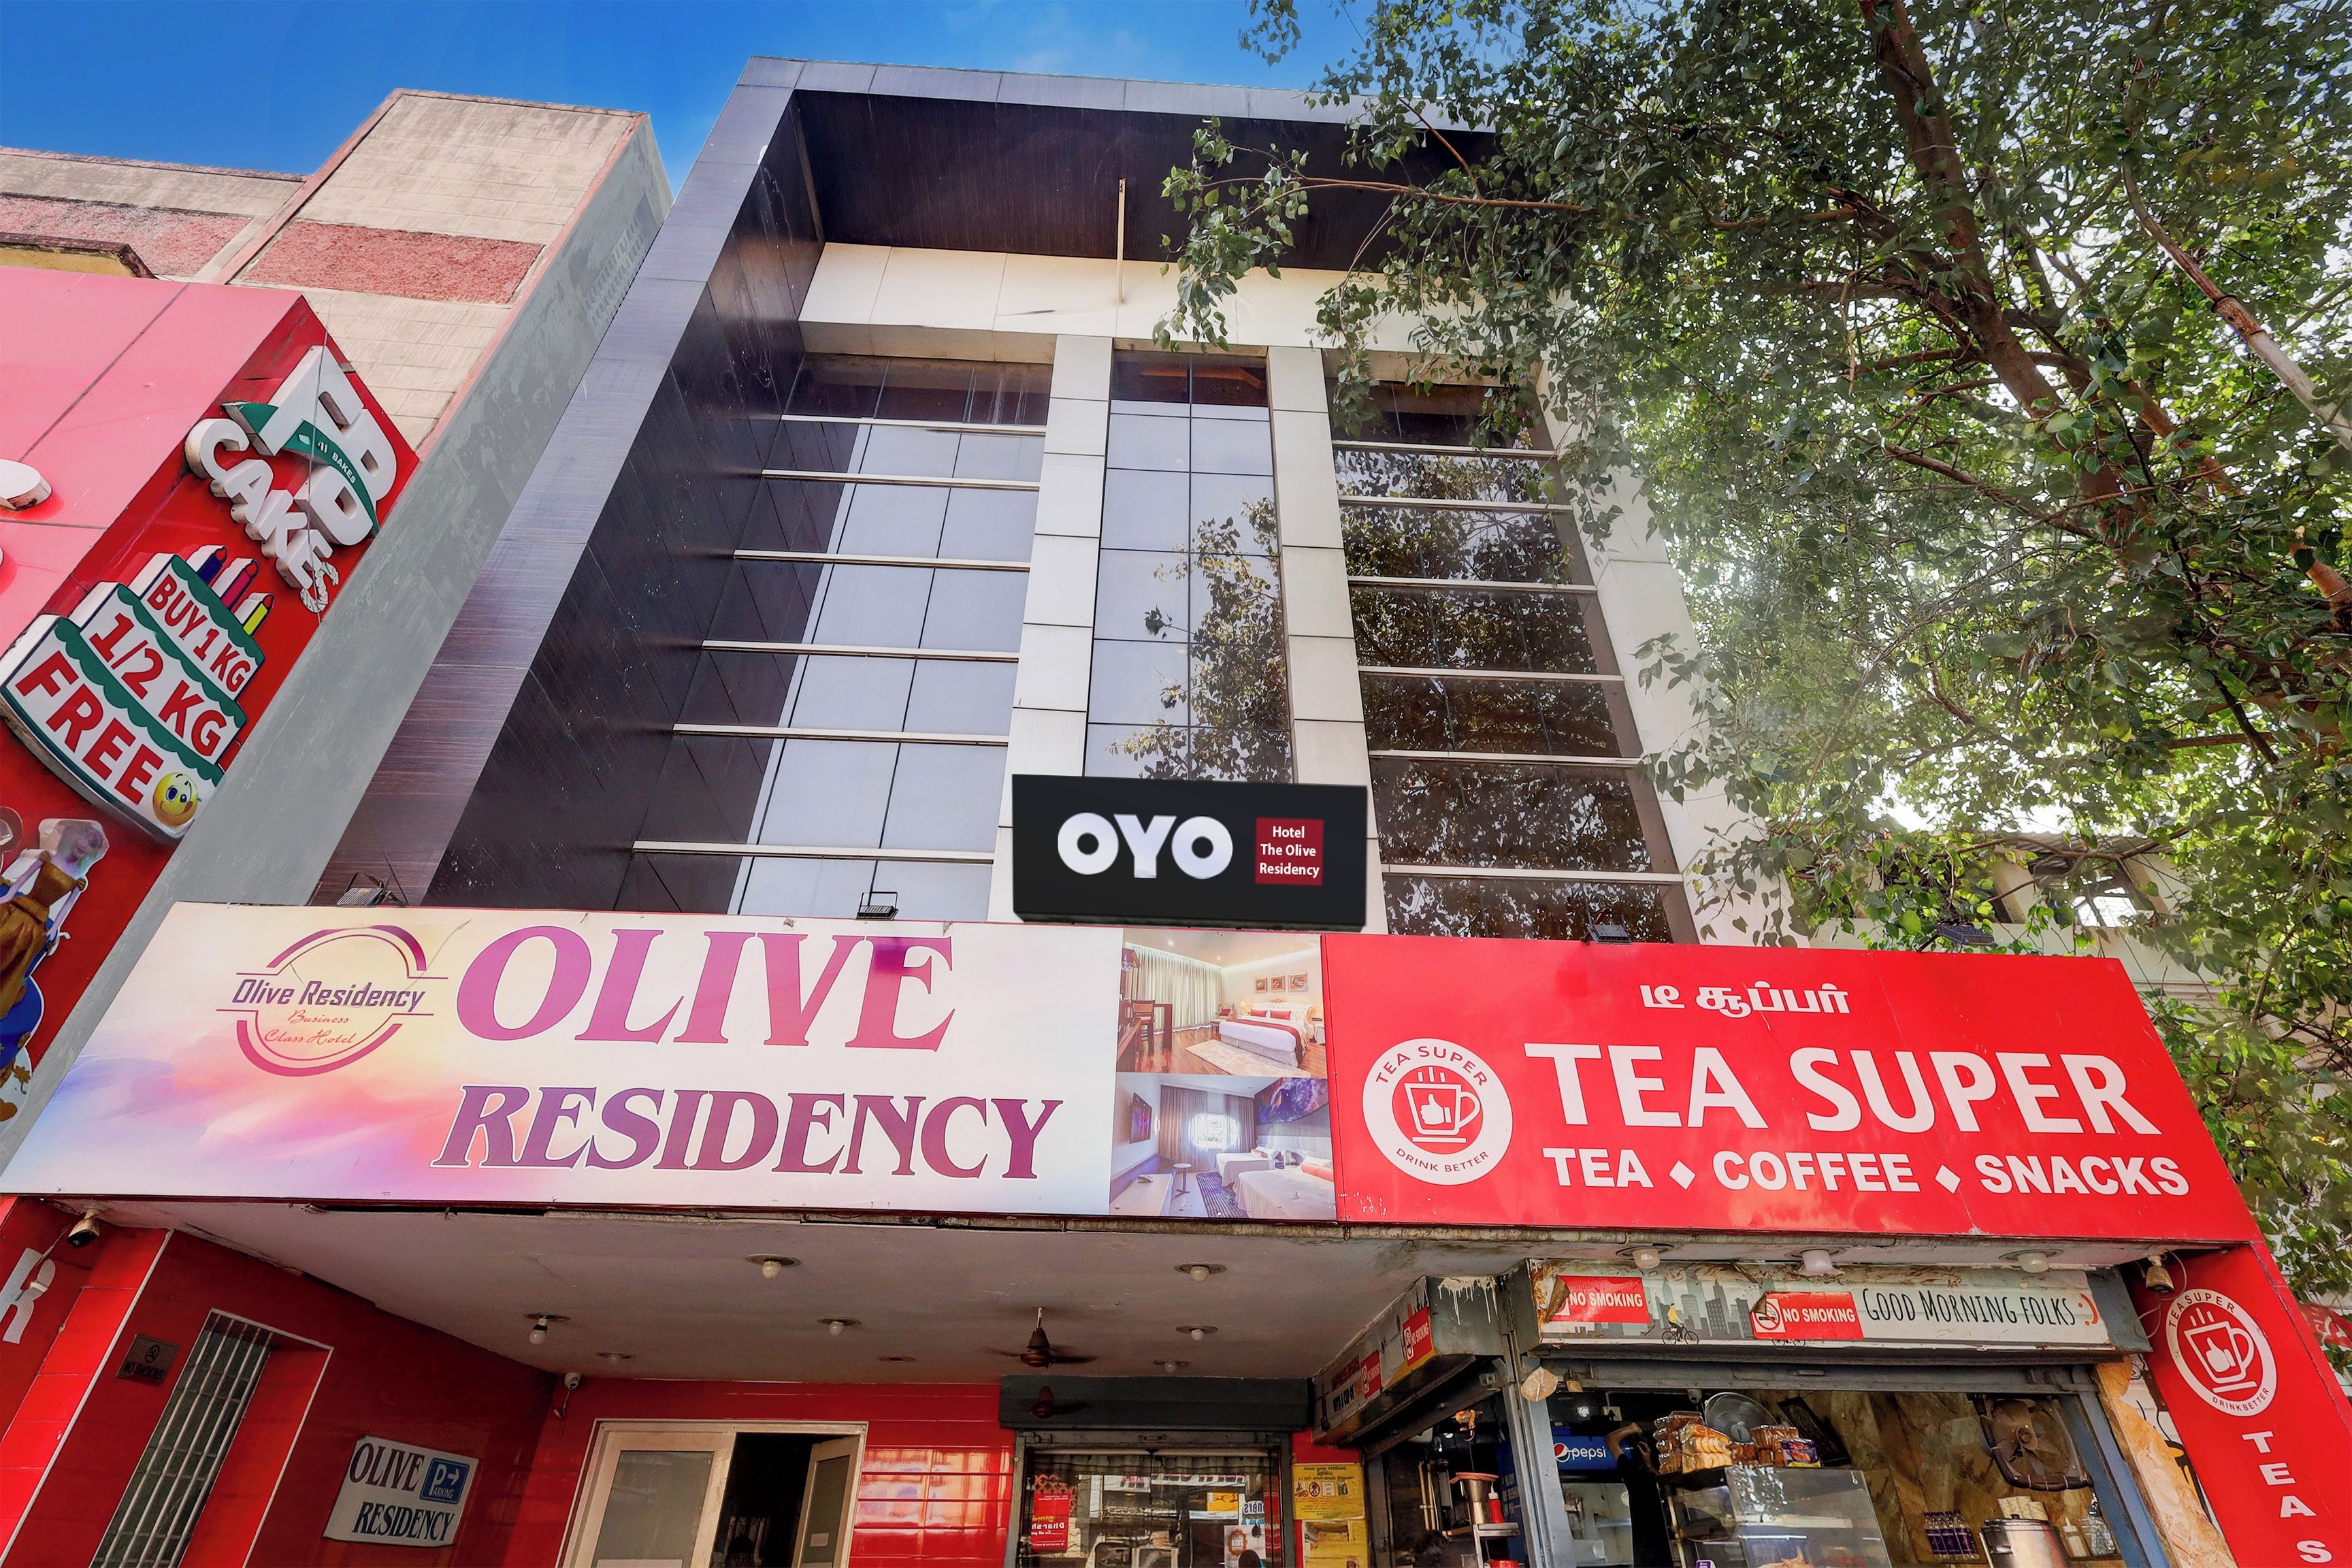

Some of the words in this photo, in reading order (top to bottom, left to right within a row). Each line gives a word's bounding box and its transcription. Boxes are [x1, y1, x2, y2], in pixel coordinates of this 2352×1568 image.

[331, 452, 357, 484] BAKES
[187, 417, 339, 613] CAKES
[147, 573, 208, 639] BUY
[193, 628, 219, 661] 1
[210, 642, 251, 693] KG
[89, 613, 164, 700] 1/2
[158, 679, 227, 757] KG
[15, 650, 165, 805] FREE
[1057, 812, 1233, 879] OYO
[1260, 843, 1283, 856] The
[1285, 845, 1316, 858] Olive
[1272, 826, 1305, 838] Hotel
[1259, 862, 1320, 879] Residency
[231, 979, 295, 1004] Olive
[298, 980, 426, 1013] Residency
[455, 924, 956, 1053] OLIVE
[1695, 980, 1851, 1019] சூப்பர்
[263, 1028, 304, 1043] Class
[306, 1029, 358, 1045] Hotel
[287, 1009, 350, 1025] Business
[1375, 1052, 1411, 1084] TEA
[1417, 1045, 1488, 1087] SUPER
[1522, 1042, 1769, 1129] TEA
[1789, 1046, 2163, 1136] SUPER
[429, 1084, 1064, 1180] RESIDENCY
[1396, 1147, 1439, 1172] DRINK
[1444, 1150, 1490, 1173] BETTER
[1541, 1146, 1655, 1188] TEA
[1712, 1149, 1921, 1193] COFFEE
[1974, 1154, 2190, 1196] SNACKS
[1569, 1292, 1587, 1307] NO
[1588, 1292, 1644, 1308] SMOKING
[1782, 1307, 1801, 1323] NO
[1803, 1307, 1857, 1324] SMOKING
[2019, 1296, 2076, 1326] FOLKS
[349, 1442, 425, 1492] OLIVE
[1571, 1446, 1607, 1462] pepsi
[2241, 1431, 2318, 1518] TEA
[352, 1501, 455, 1541] RESIDENCY
